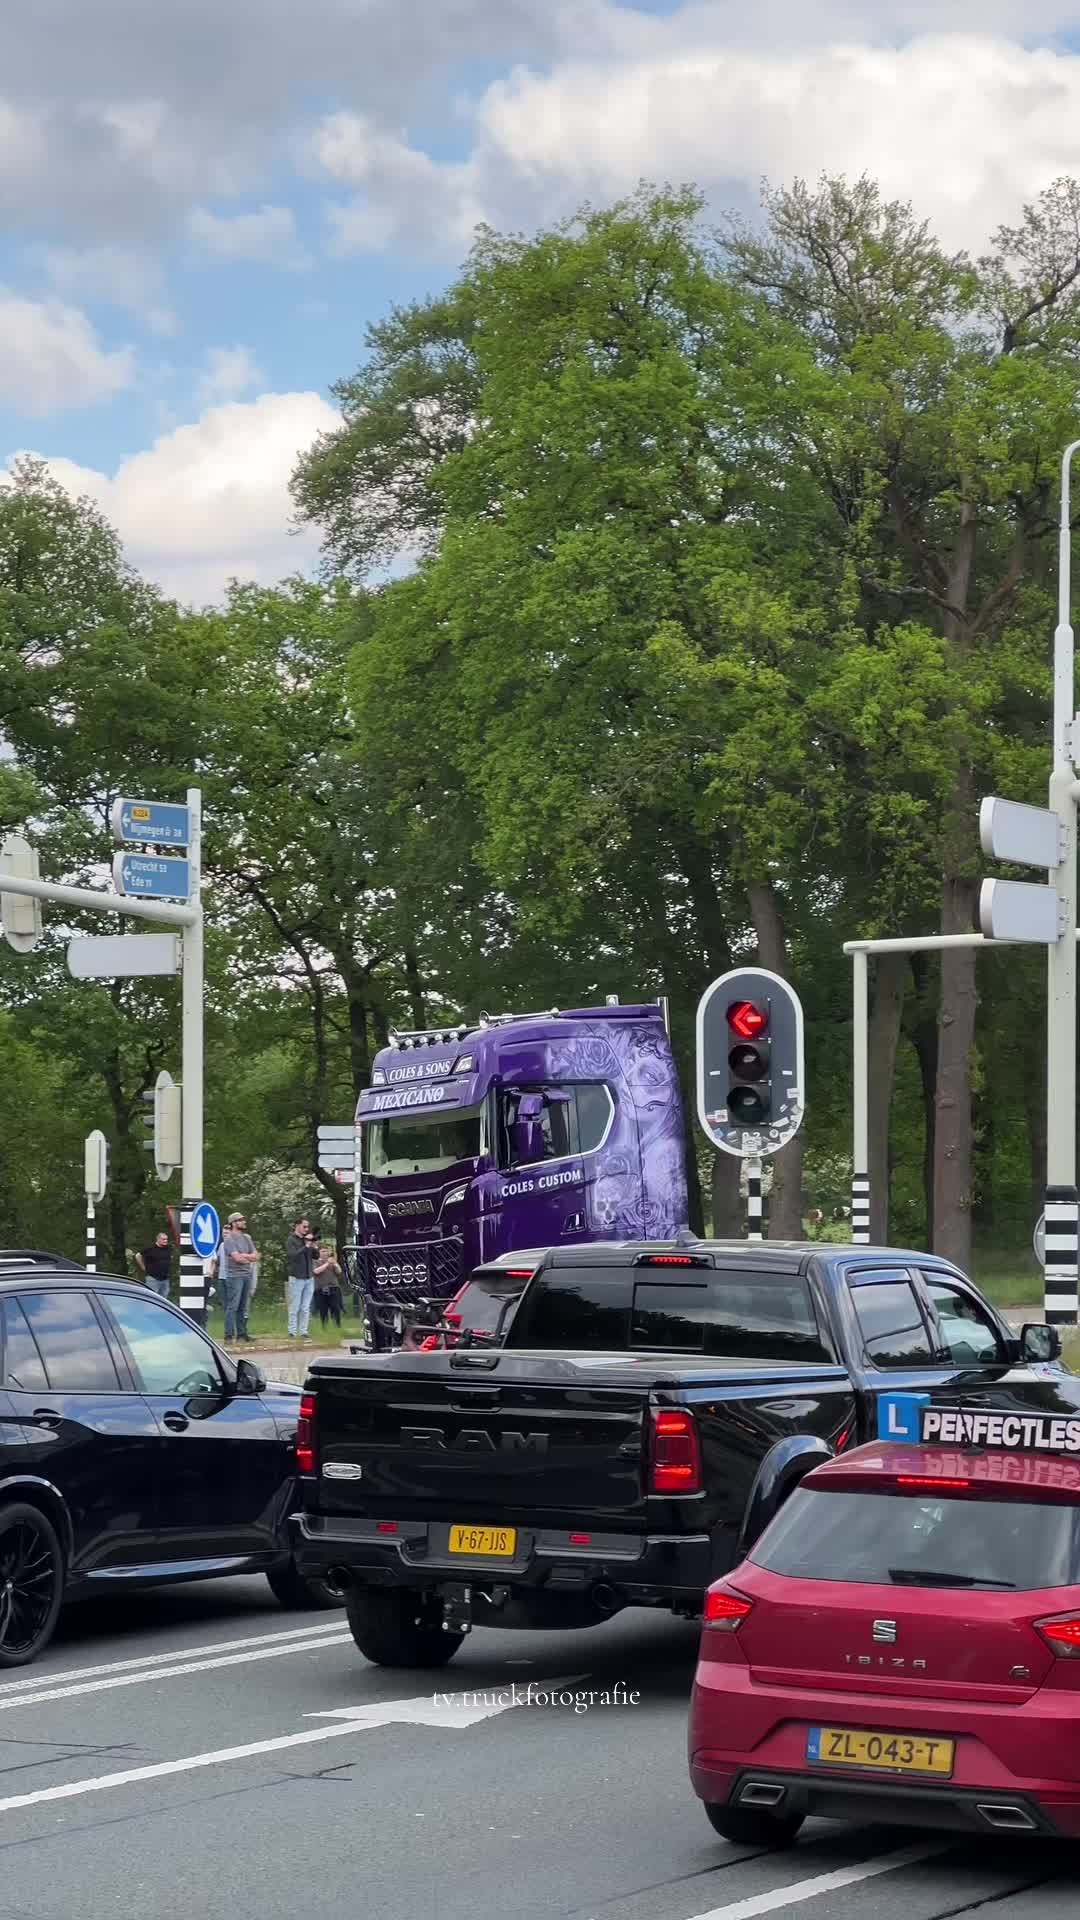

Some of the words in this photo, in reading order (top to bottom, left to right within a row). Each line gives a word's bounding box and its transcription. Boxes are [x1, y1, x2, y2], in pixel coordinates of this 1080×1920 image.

[131, 860, 157, 872] Utrecht
[131, 876, 144, 887] Ede
[389, 1066, 416, 1082] COLES
[417, 1064, 424, 1077] &
[425, 1060, 451, 1076] SONS
[372, 1087, 445, 1112] MEXICANO
[501, 1180, 534, 1197] COLES
[538, 1169, 581, 1188] CUSTOM
[888, 1403, 908, 1434] L
[400, 1426, 550, 1454] RAM
[458, 1529, 507, 1550] V-67-JJS
[845, 1654, 927, 1669] IBIZA
[828, 1732, 940, 1766] ZL-043-T
